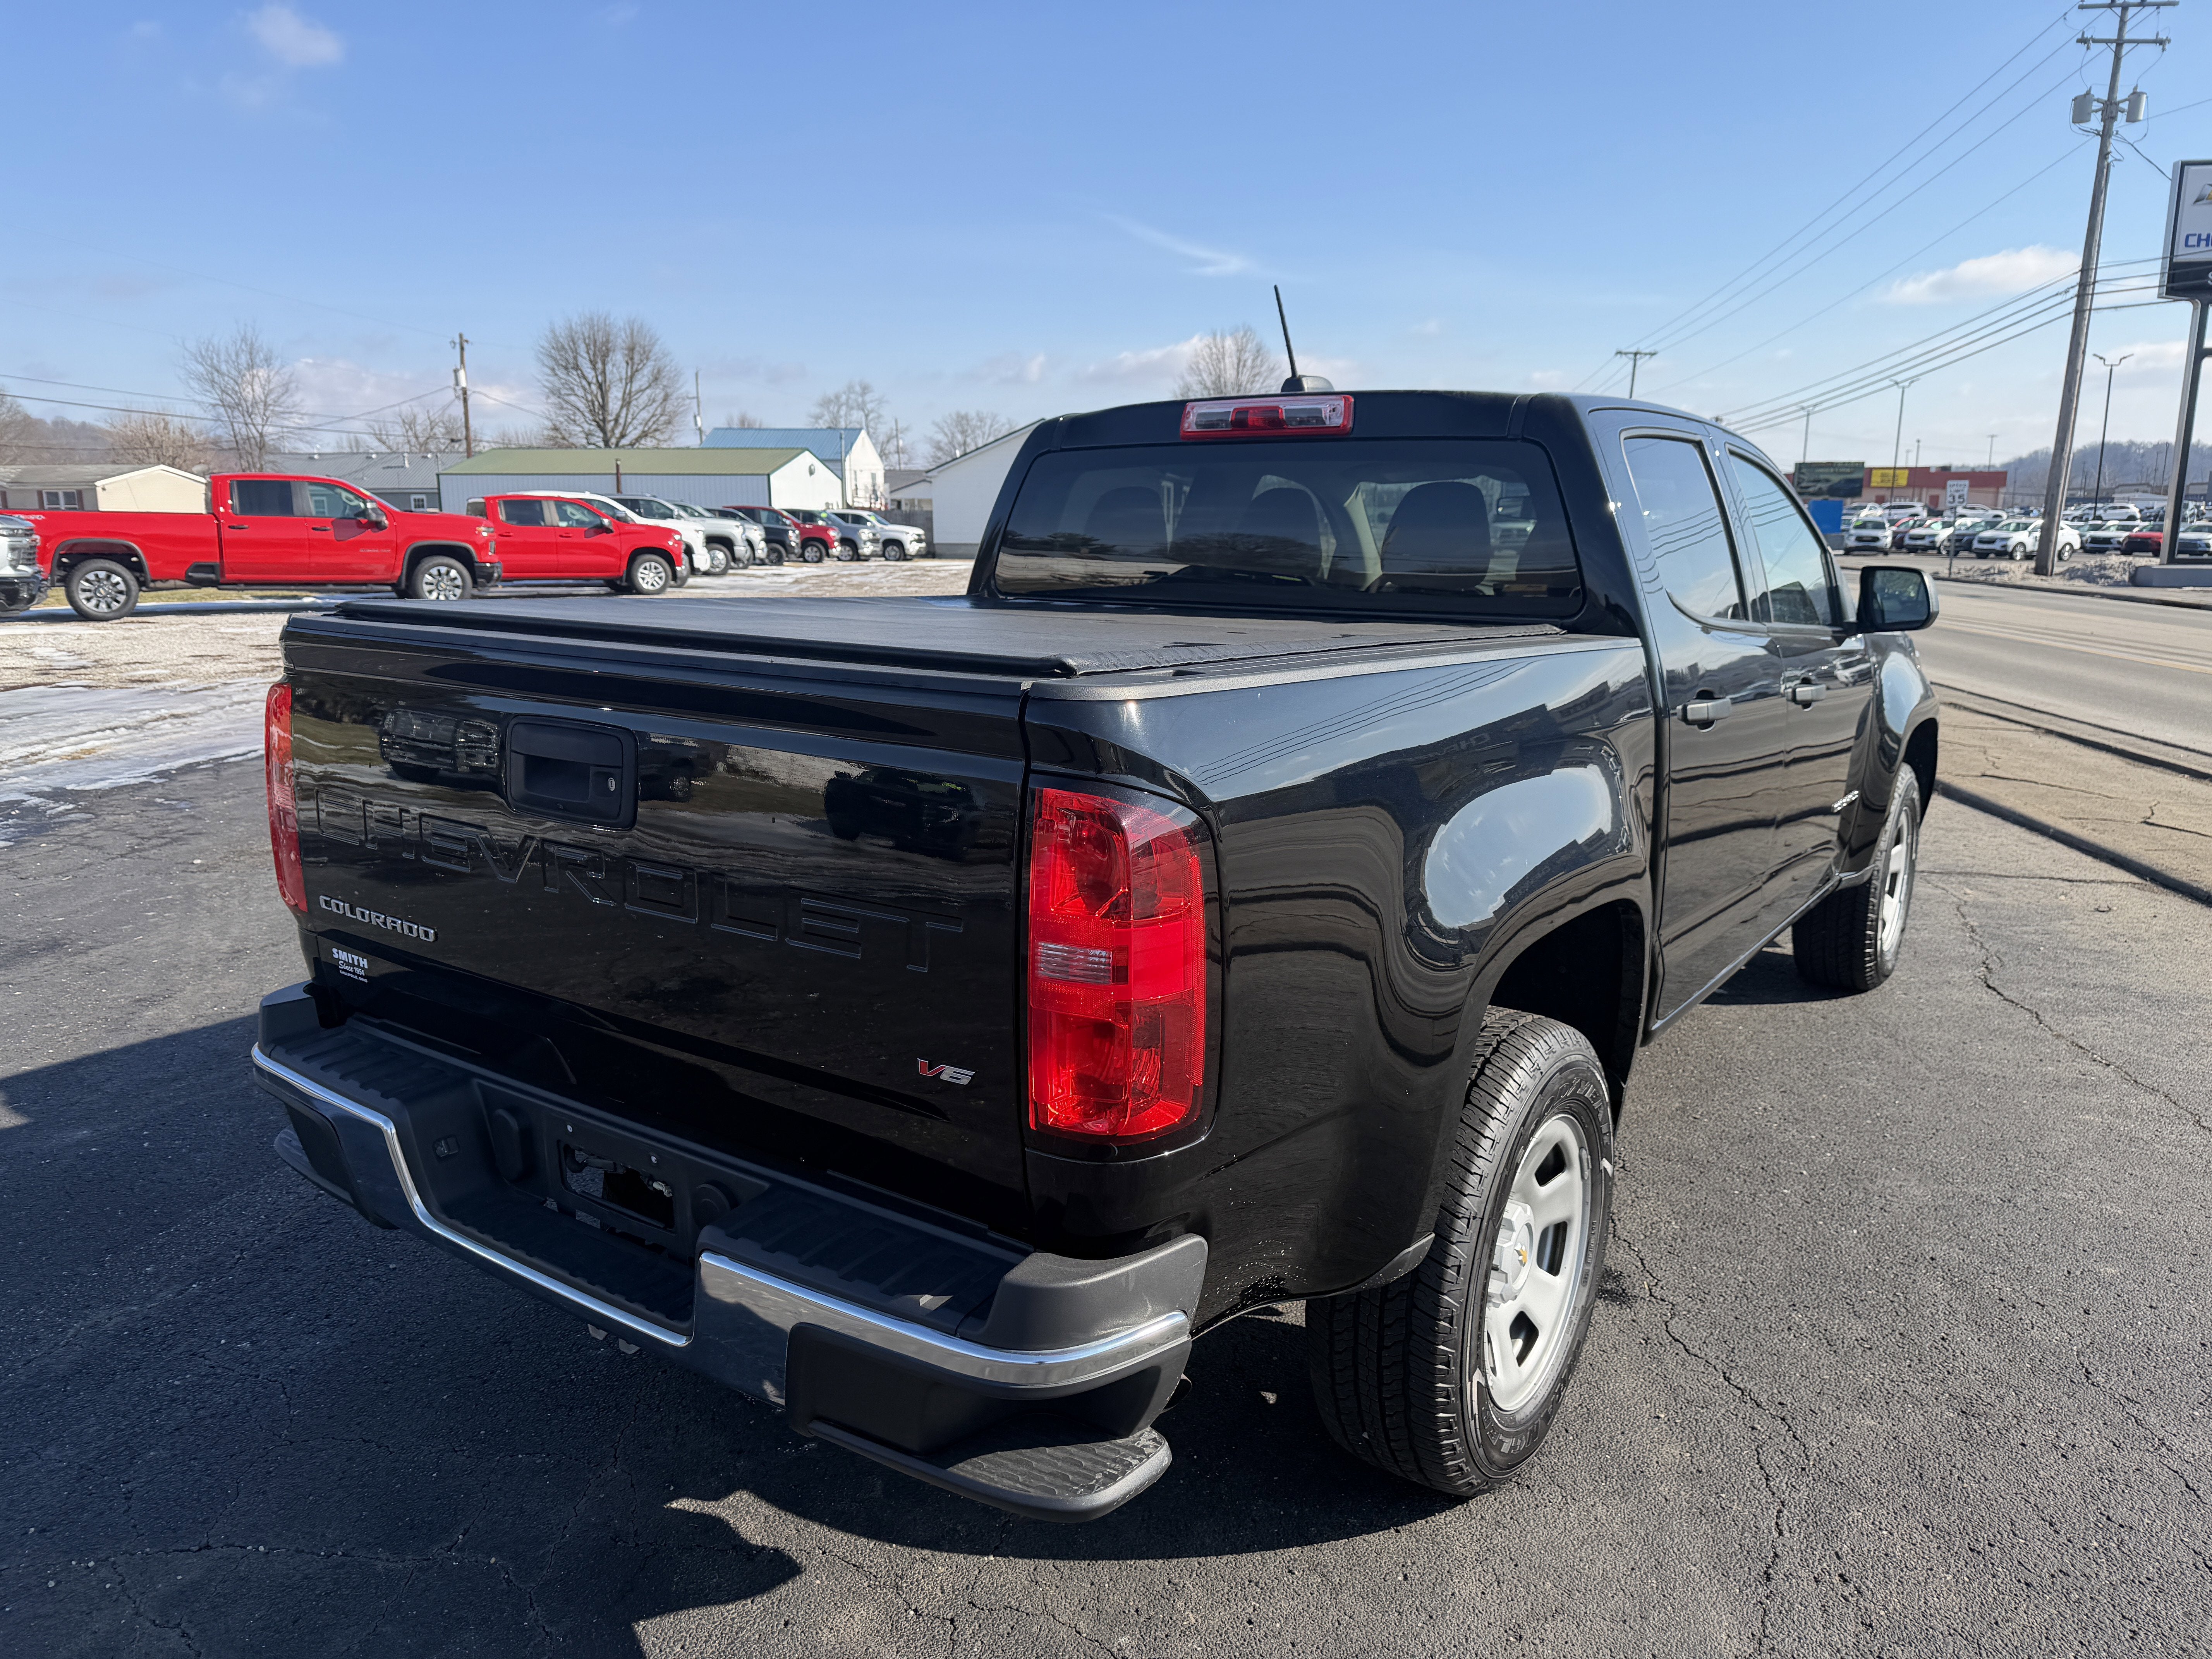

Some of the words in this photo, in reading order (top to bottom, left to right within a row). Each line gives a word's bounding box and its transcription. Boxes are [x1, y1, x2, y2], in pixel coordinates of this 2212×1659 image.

[2185, 233, 2212, 247] CH
[1948, 493, 1965, 504] 35
[315, 788, 963, 972] CHEVROLET
[319, 895, 437, 942] COLORADO
[332, 948, 368, 969] SMITH
[338, 960, 354, 972] Since
[917, 1058, 976, 1085] V6
[1516, 1077, 1610, 1166] GOODYEAR
